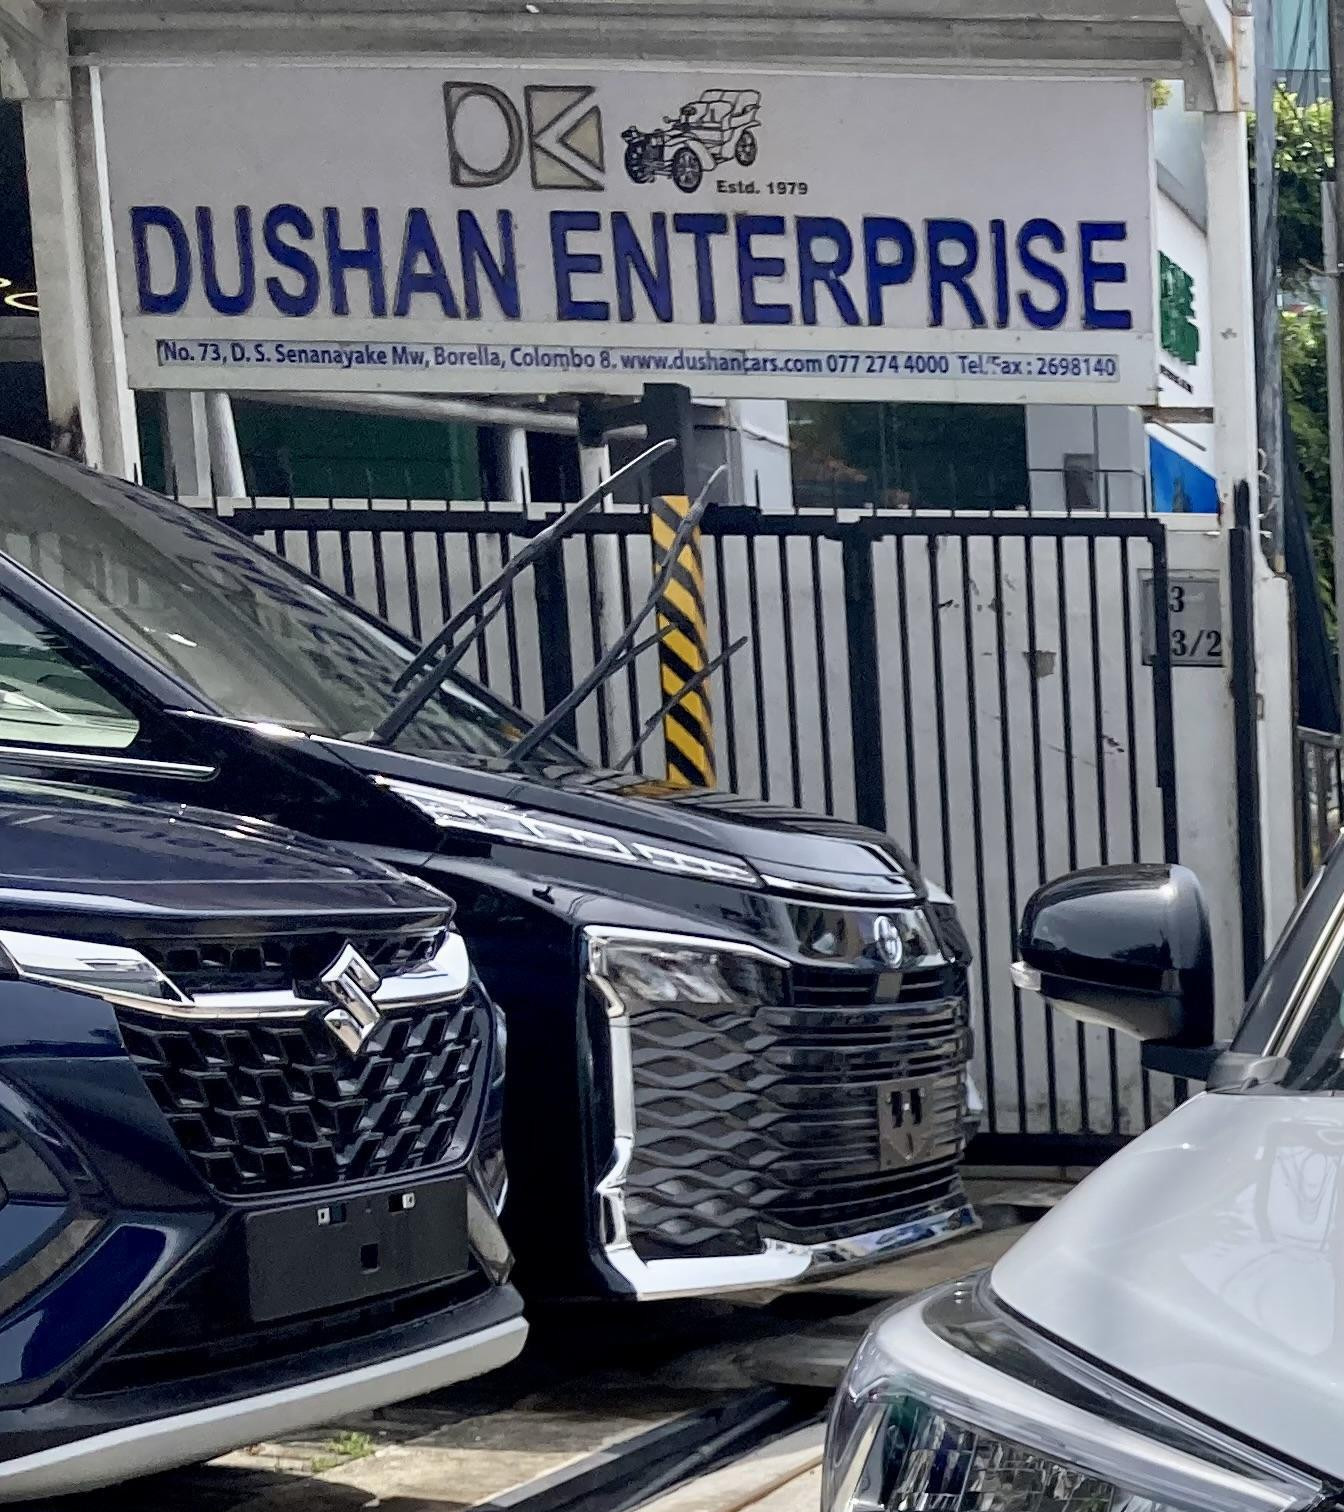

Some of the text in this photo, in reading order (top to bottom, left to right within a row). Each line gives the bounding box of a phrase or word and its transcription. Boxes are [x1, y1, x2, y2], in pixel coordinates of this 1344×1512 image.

[714, 180, 809, 196] Estd. 1979
[130, 203, 521, 321] DUSHAN
[550, 208, 1134, 331] ENTERPRISE
[164, 342, 195, 362] No.
[199, 343, 228, 365] 73,
[231, 343, 251, 362] D.
[255, 344, 272, 363] S.
[276, 344, 387, 369] Senanayake
[391, 345, 431, 369] Mw,
[434, 346, 506, 370] Borella,
[510, 346, 595, 370] Colombo
[620, 349, 823, 373] www.dushancars.com
[826, 353, 861, 374] 077
[865, 353, 899, 375] 274
[903, 354, 949, 375] 4000
[1036, 356, 1117, 377] 2698140
